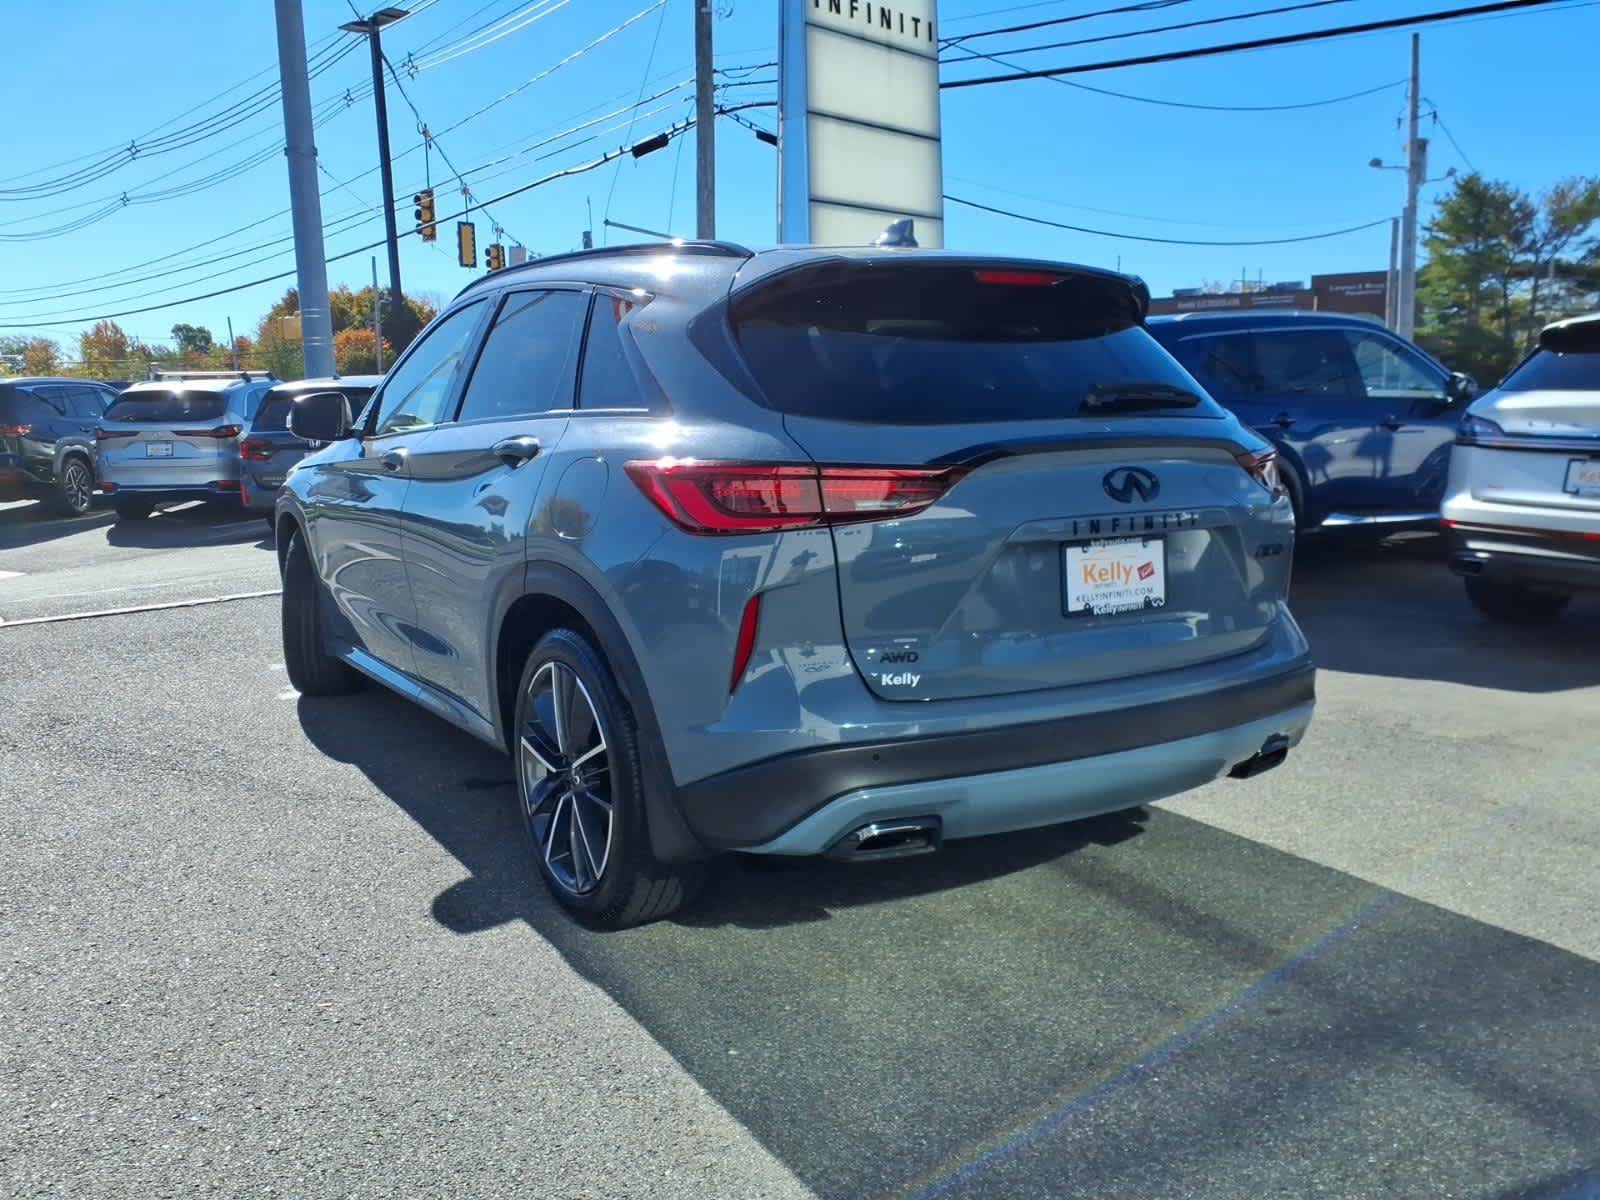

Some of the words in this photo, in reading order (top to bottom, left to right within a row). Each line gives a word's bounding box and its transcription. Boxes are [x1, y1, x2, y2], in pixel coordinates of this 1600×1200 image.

[1073, 512, 1198, 535] INFINITI
[1083, 562, 1133, 584] Kelly
[880, 651, 919, 664] AWD
[881, 672, 920, 687] Kelly
